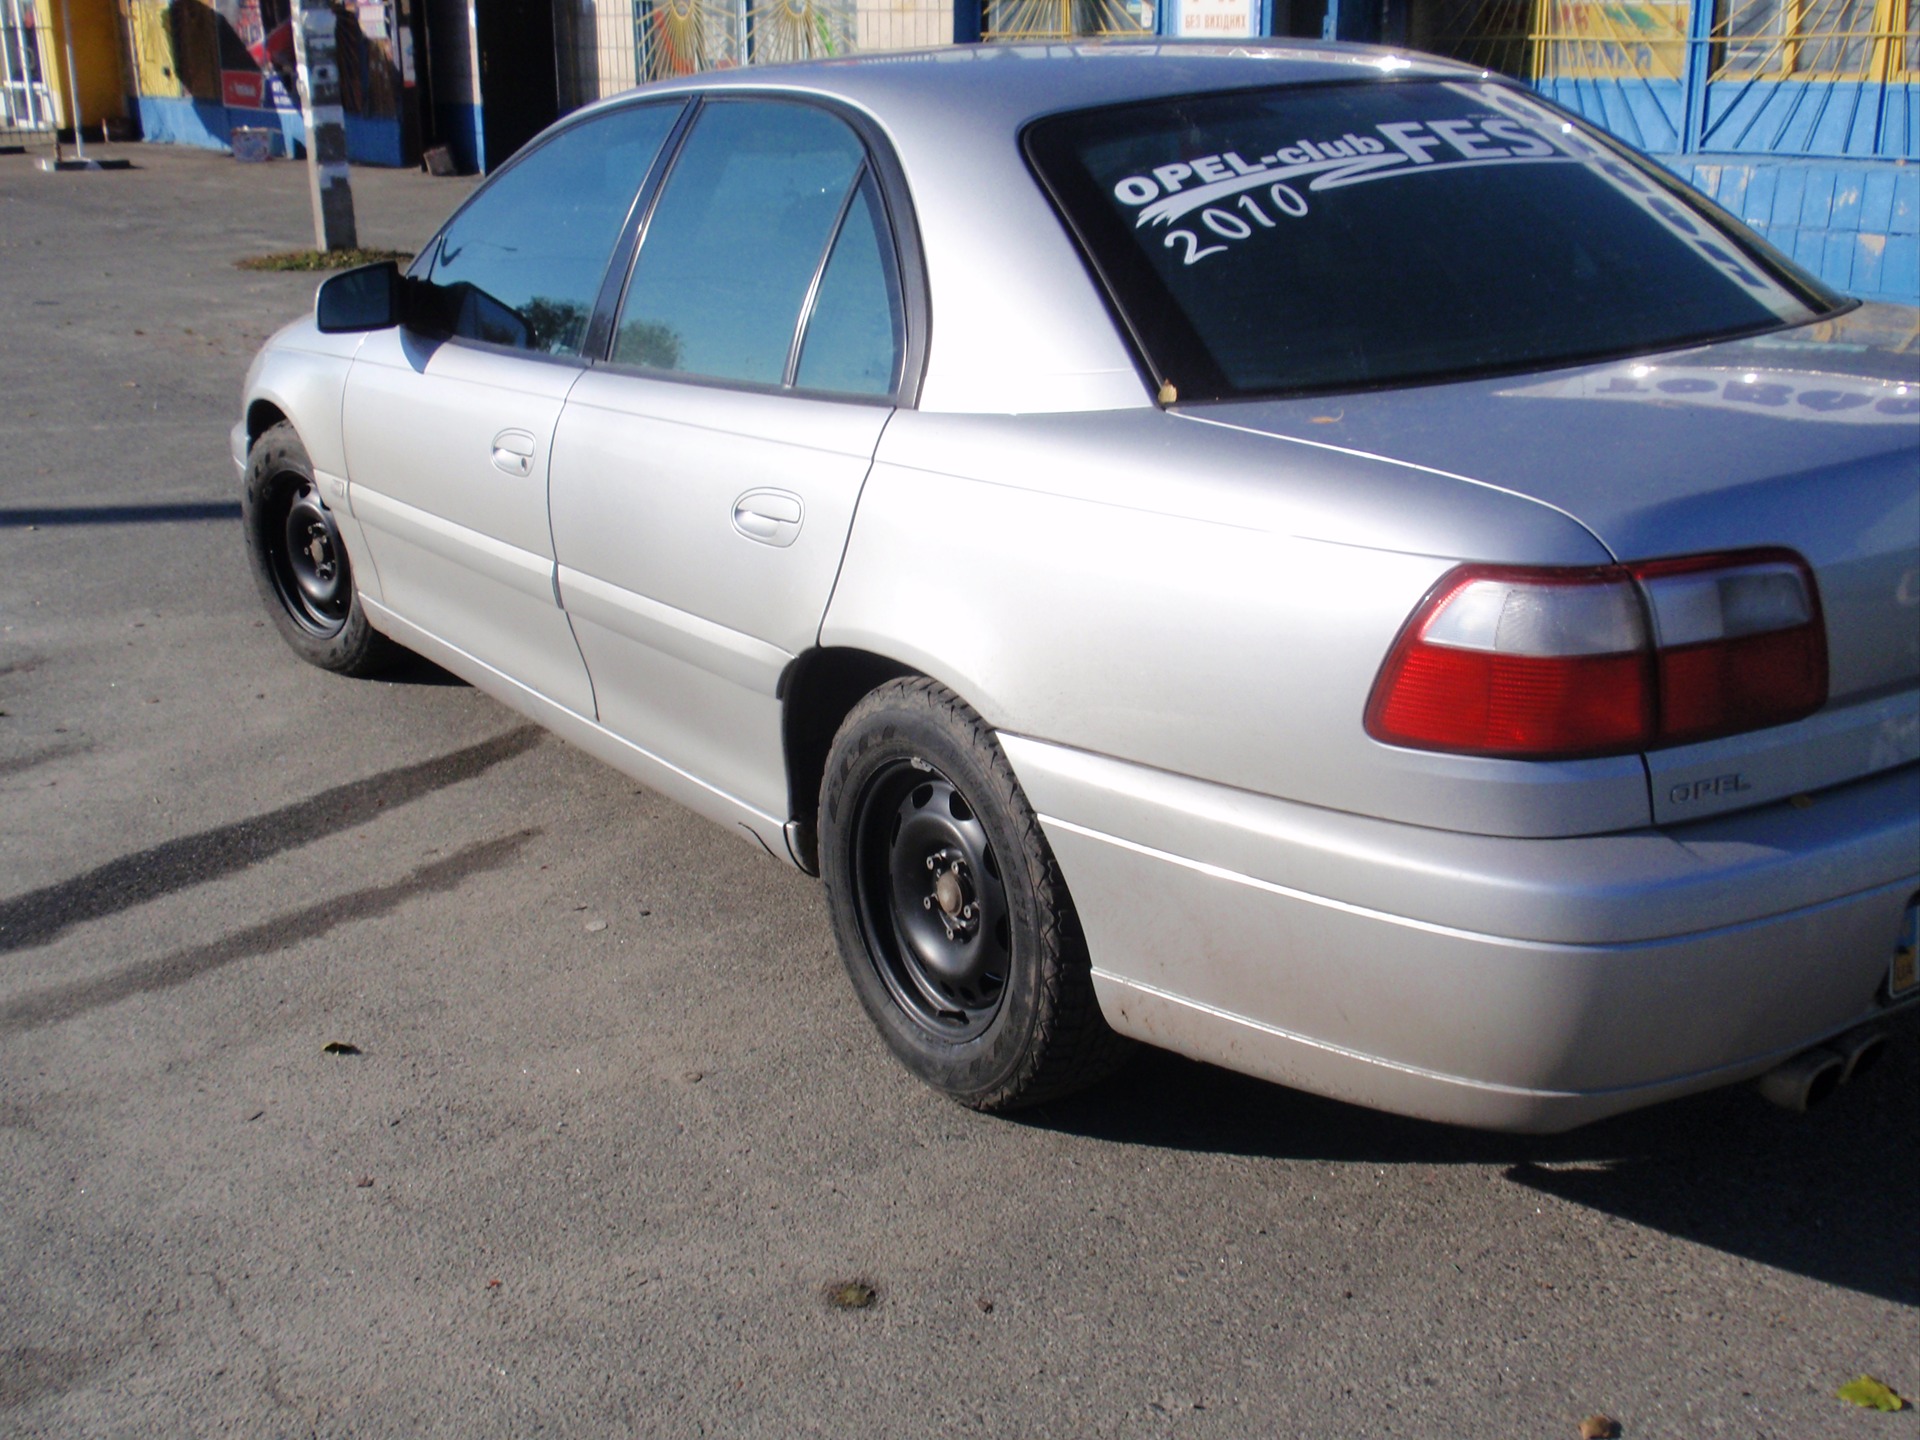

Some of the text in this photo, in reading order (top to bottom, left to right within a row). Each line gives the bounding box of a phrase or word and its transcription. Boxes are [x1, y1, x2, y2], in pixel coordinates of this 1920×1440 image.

[1185, 14, 1201, 29] БЕЗ
[1113, 132, 1386, 206] OPEL-club
[1163, 182, 1309, 265] 2010
[1669, 772, 1752, 805] OPEL
